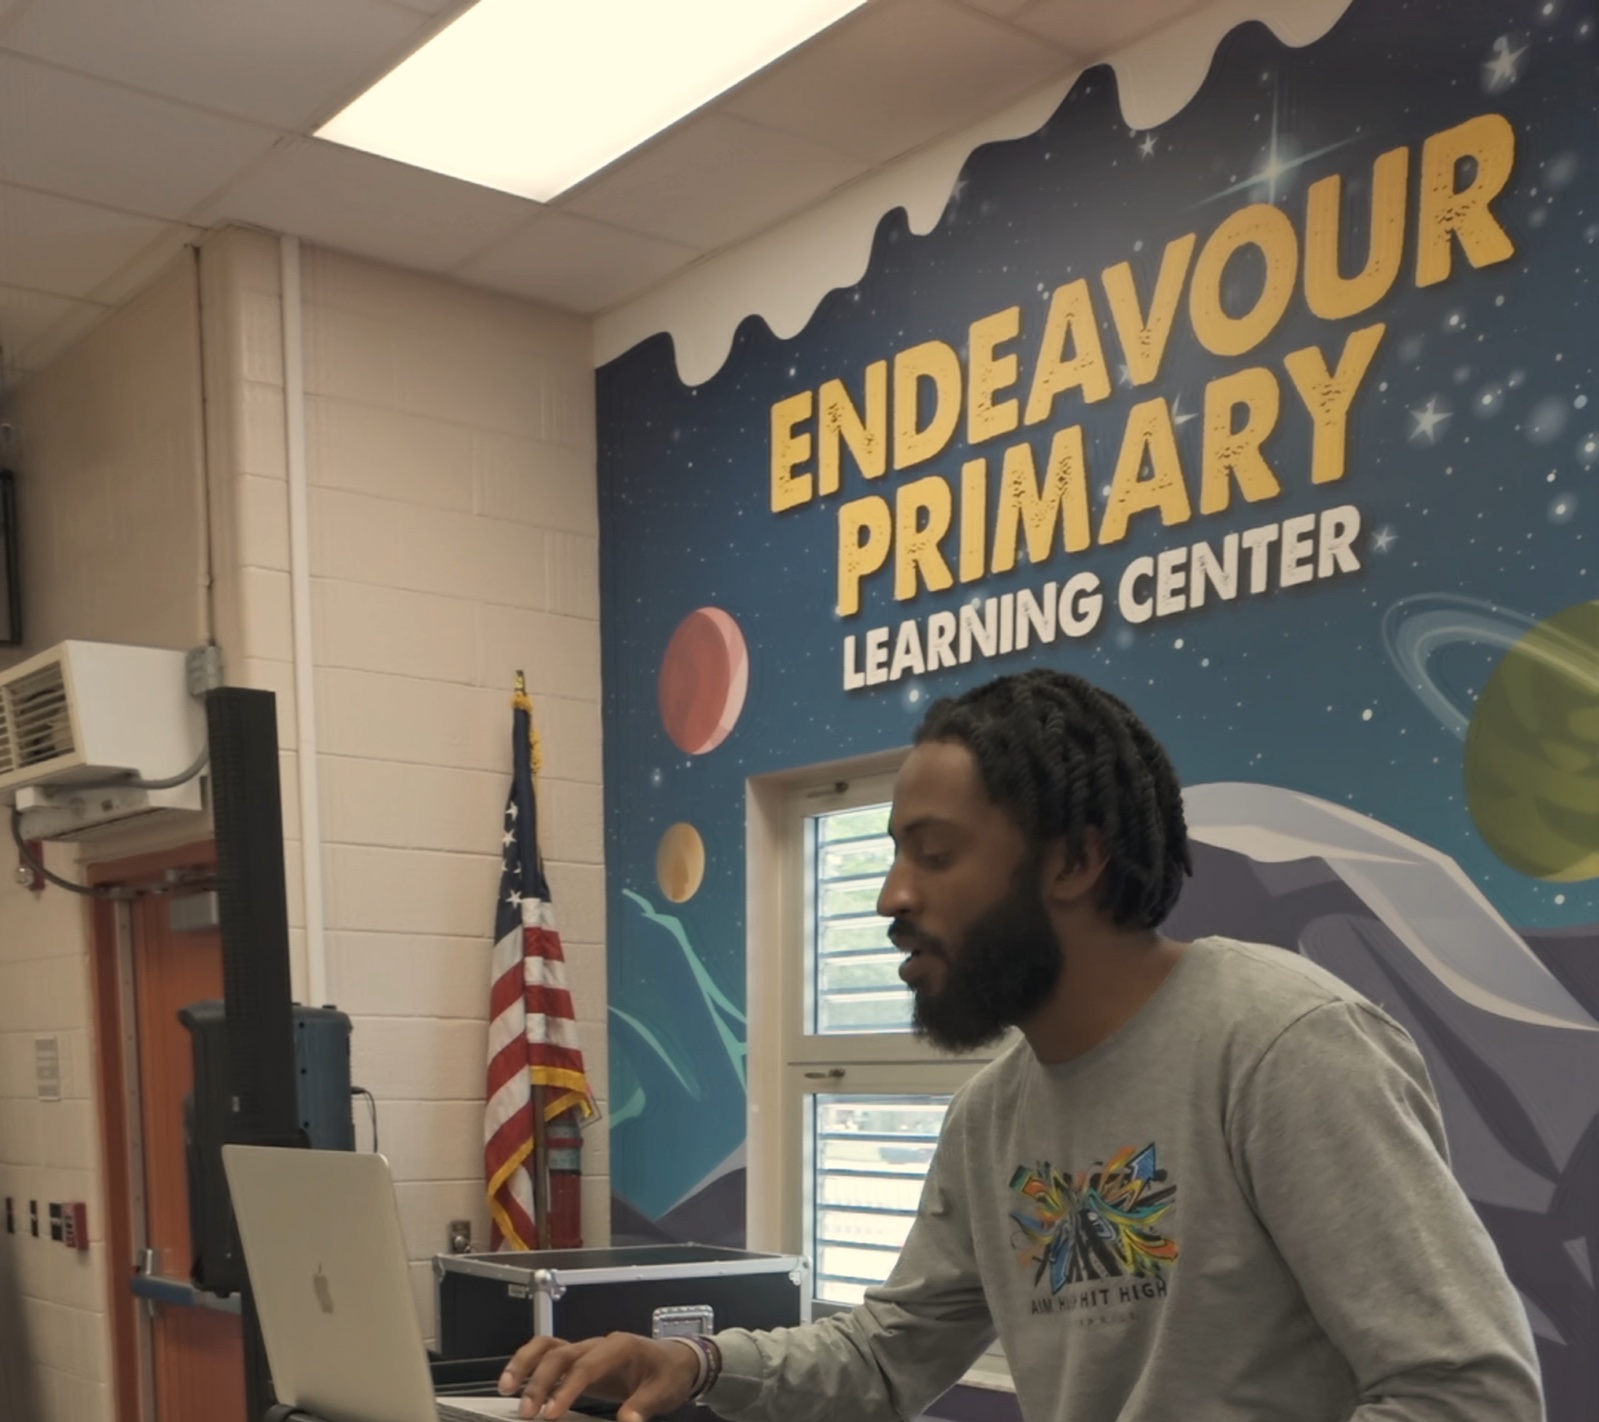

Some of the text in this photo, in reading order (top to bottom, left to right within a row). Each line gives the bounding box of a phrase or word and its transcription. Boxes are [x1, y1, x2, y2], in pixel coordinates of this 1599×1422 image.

[770, 113, 1516, 513] ENDEAVOUR
[837, 322, 1386, 617] PRIMARY
[842, 504, 1362, 691] LEARNING CENTER
[1080, 1289, 1109, 1308] HIT
[1120, 1280, 1168, 1303] HIGH
